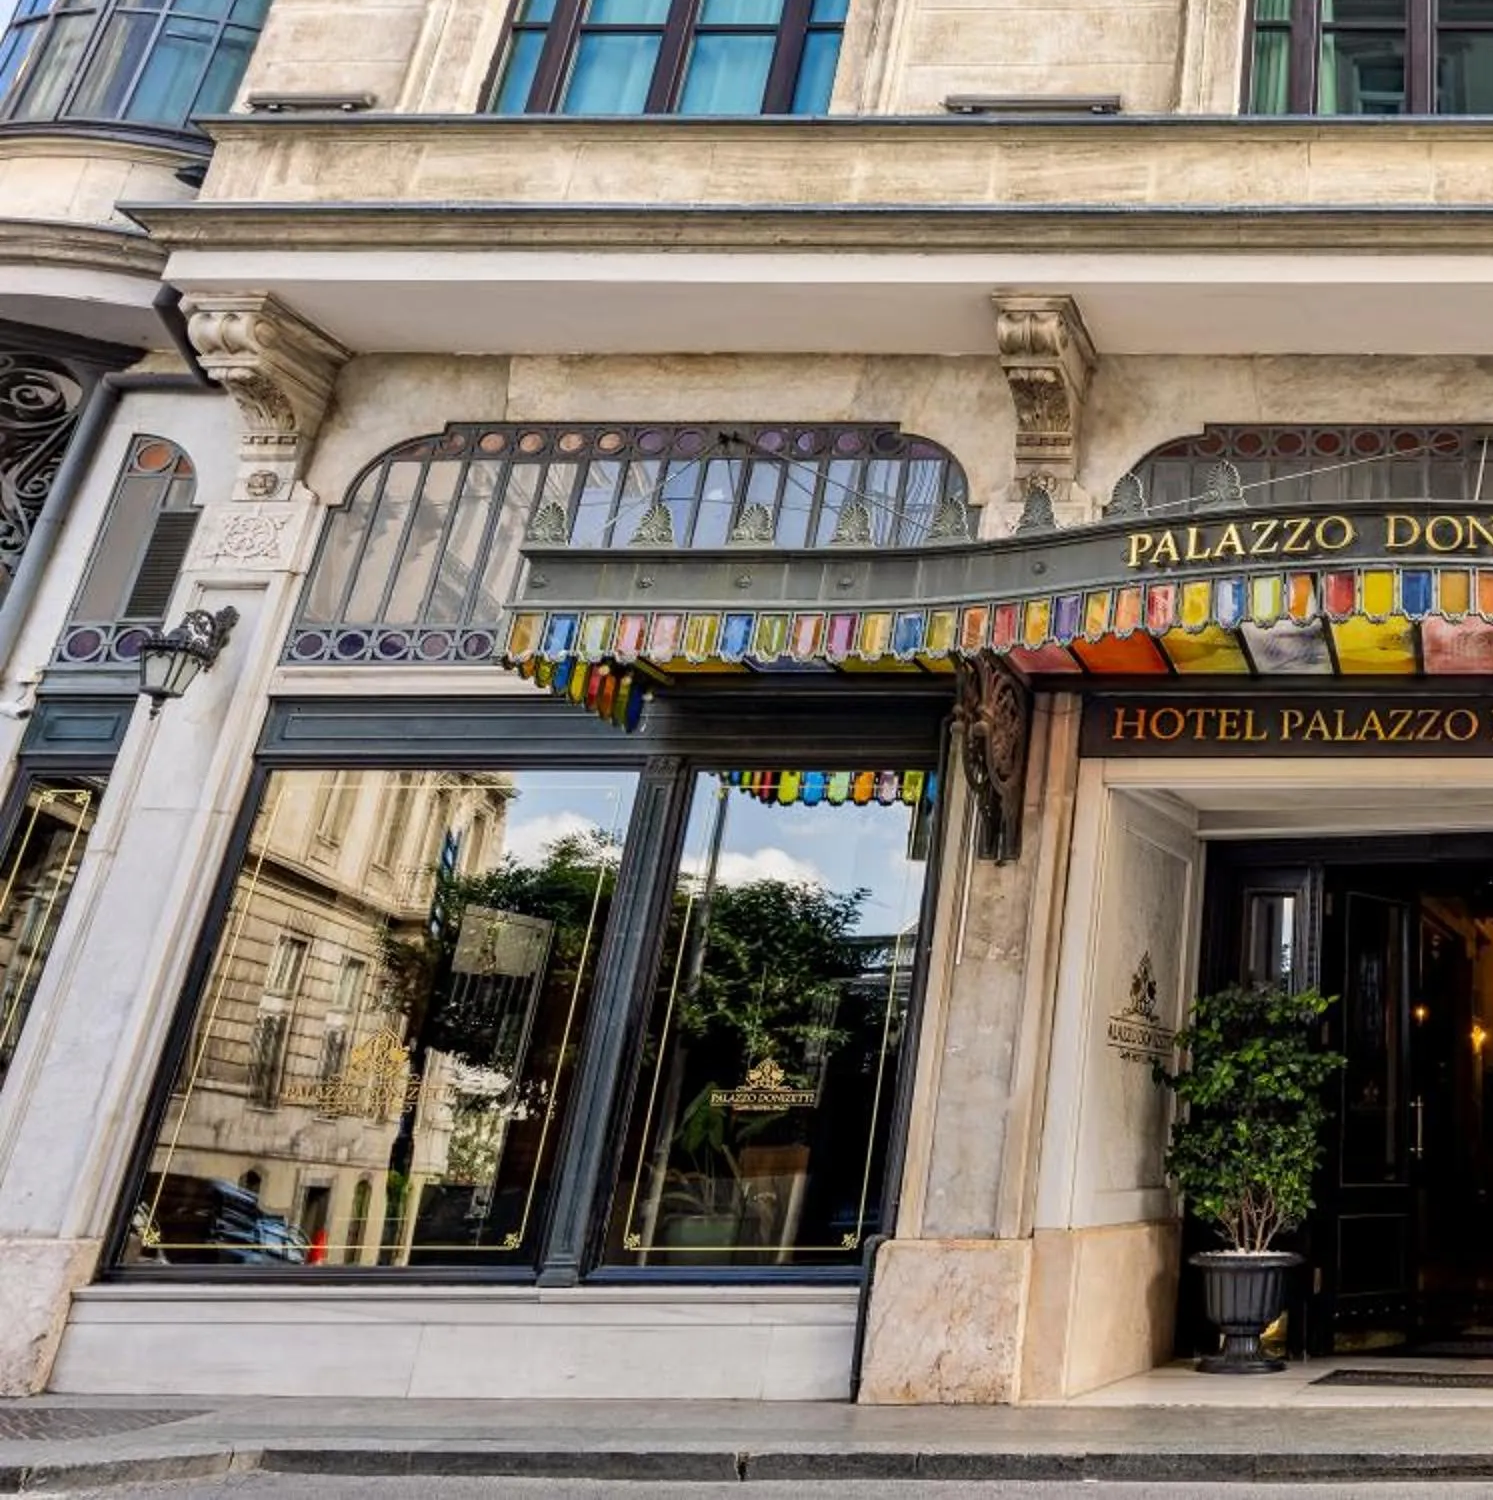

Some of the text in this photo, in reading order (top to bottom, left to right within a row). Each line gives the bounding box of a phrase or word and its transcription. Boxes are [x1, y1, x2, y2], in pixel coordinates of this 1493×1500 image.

[1127, 515, 1352, 567] PALAZZO
[1112, 707, 1267, 740] HOTEL
[1280, 709, 1479, 741] PALAZZO
[711, 1093, 757, 1103] PALAZZO
